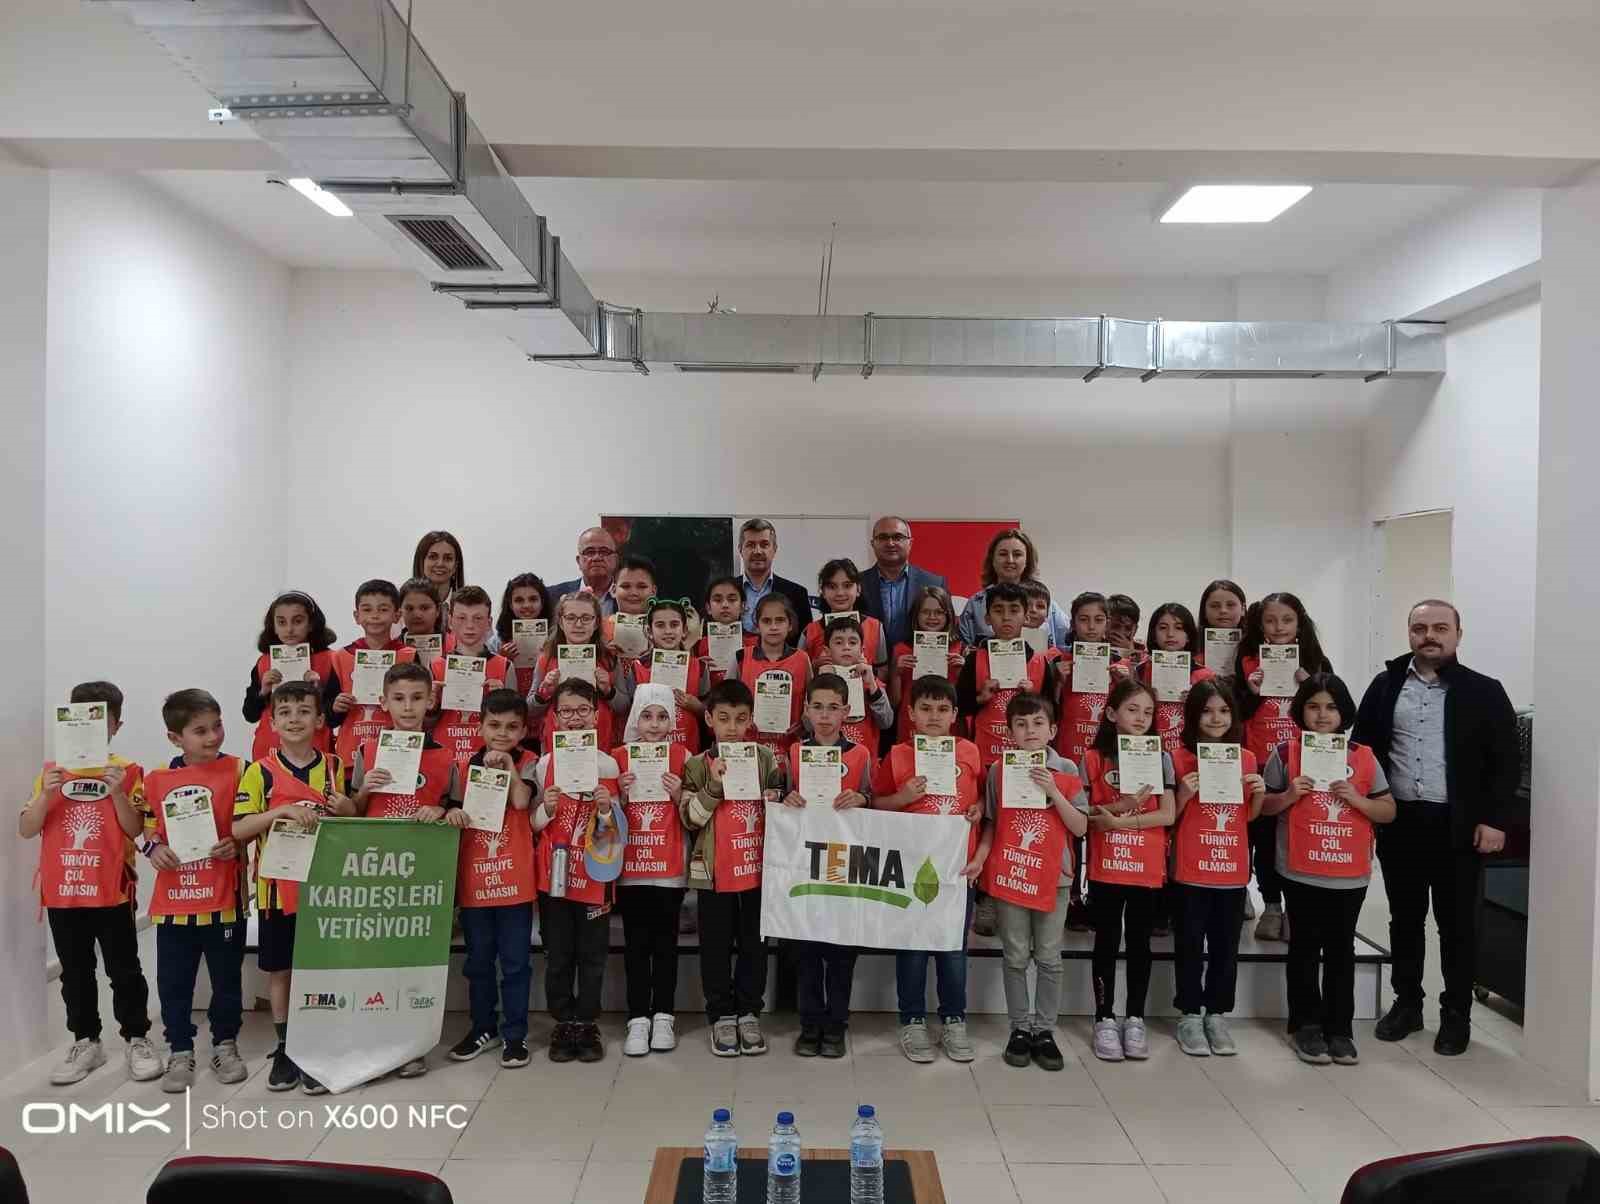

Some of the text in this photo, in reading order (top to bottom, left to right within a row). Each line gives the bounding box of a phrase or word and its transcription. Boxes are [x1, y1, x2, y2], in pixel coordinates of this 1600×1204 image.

[72, 782, 98, 793] TEMA
[1309, 822, 1352, 837] TÜRKİYE
[1104, 831, 1144, 846] TÜRKİYE
[1200, 832, 1239, 846] TÜRKİYE
[1321, 837, 1341, 851] ÇÖL
[636, 846, 655, 861] ÇÖL
[1002, 848, 1043, 869] TÜRKİYE
[1114, 846, 1133, 861] ÇÖL
[1211, 846, 1230, 860] ÇÖL
[1308, 850, 1352, 863] OLMASIN
[342, 846, 416, 878] AĞAÇ
[473, 858, 513, 874] TÜRKİYE
[625, 861, 667, 872] OLMASIN
[805, 840, 905, 889] TEMA
[1102, 859, 1144, 872] OLMASIN
[1199, 859, 1238, 873] OLMASIN
[179, 871, 200, 888] ÇÖL
[1009, 864, 1029, 880] ÇÖL
[475, 884, 519, 900] OLMASIN
[996, 873, 1039, 896] OLMASIN
[167, 887, 214, 901] OLMASIN
[308, 880, 443, 910] KARDEŞLERİ
[318, 912, 432, 941] YETİŞİYOR!
[304, 993, 337, 1006] TEMA
